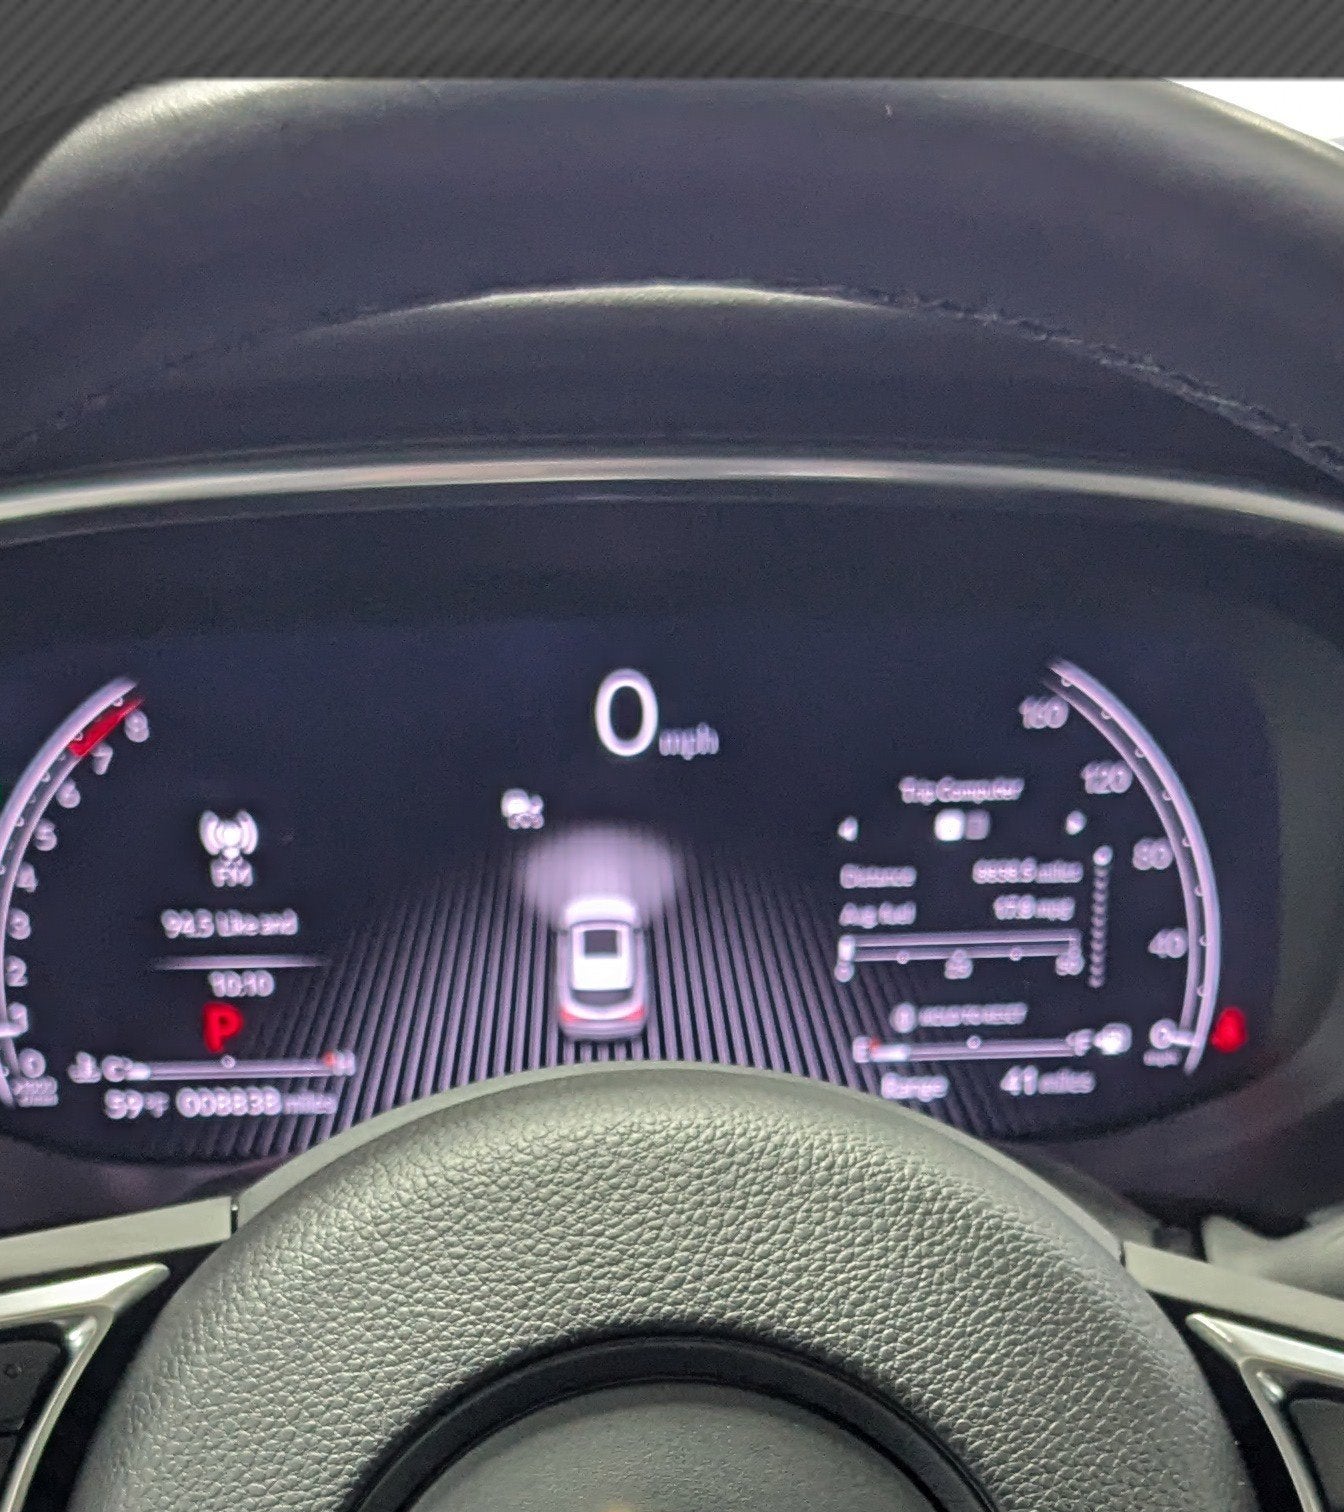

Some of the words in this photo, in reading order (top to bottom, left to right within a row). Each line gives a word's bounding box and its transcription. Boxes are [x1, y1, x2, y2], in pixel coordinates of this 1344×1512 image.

[595, 668, 659, 757] 0
[659, 722, 719, 760] mph
[93, 743, 113, 775] 7
[1081, 761, 1131, 794] 120
[10, 908, 31, 940] 3
[1148, 927, 1187, 959] 40
[7, 956, 29, 987] 2
[202, 1002, 245, 1053] P
[19, 1048, 46, 1078] 0
